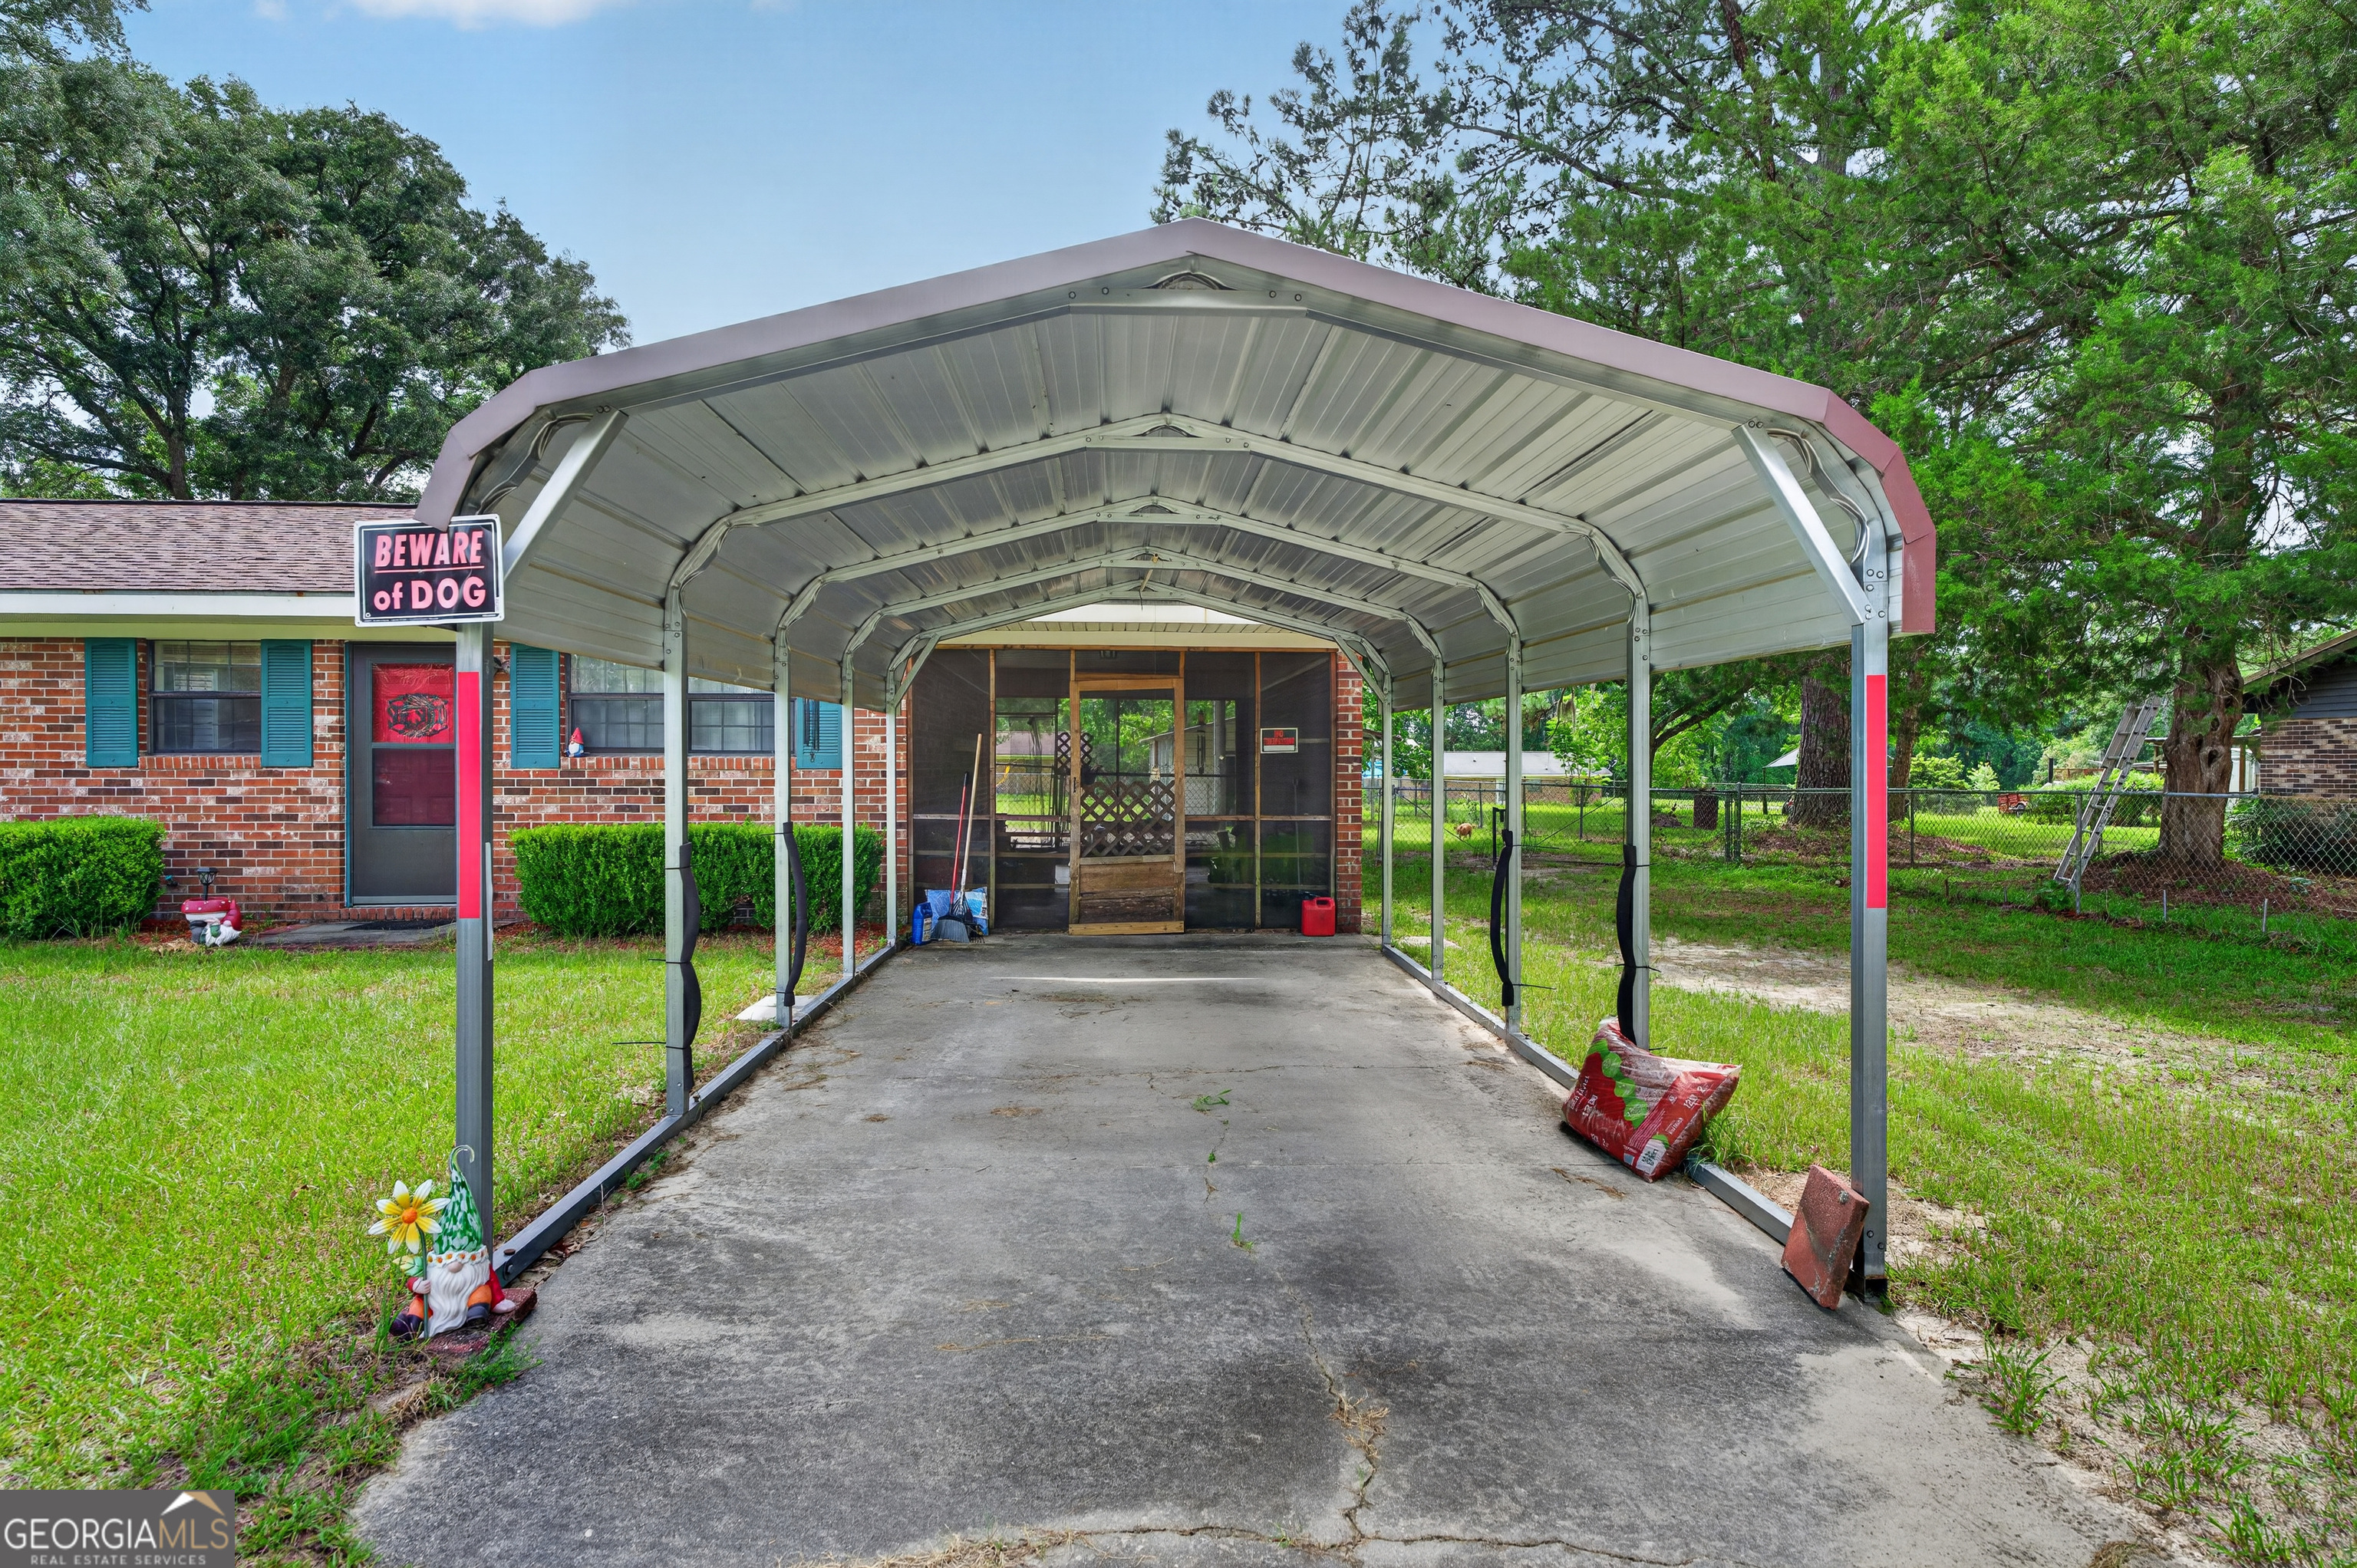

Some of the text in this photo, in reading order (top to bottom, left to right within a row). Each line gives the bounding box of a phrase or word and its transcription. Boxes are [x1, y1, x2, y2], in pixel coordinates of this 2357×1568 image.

[374, 531, 484, 567] BEWARE
[374, 581, 404, 611] of
[410, 576, 486, 610] DOG
